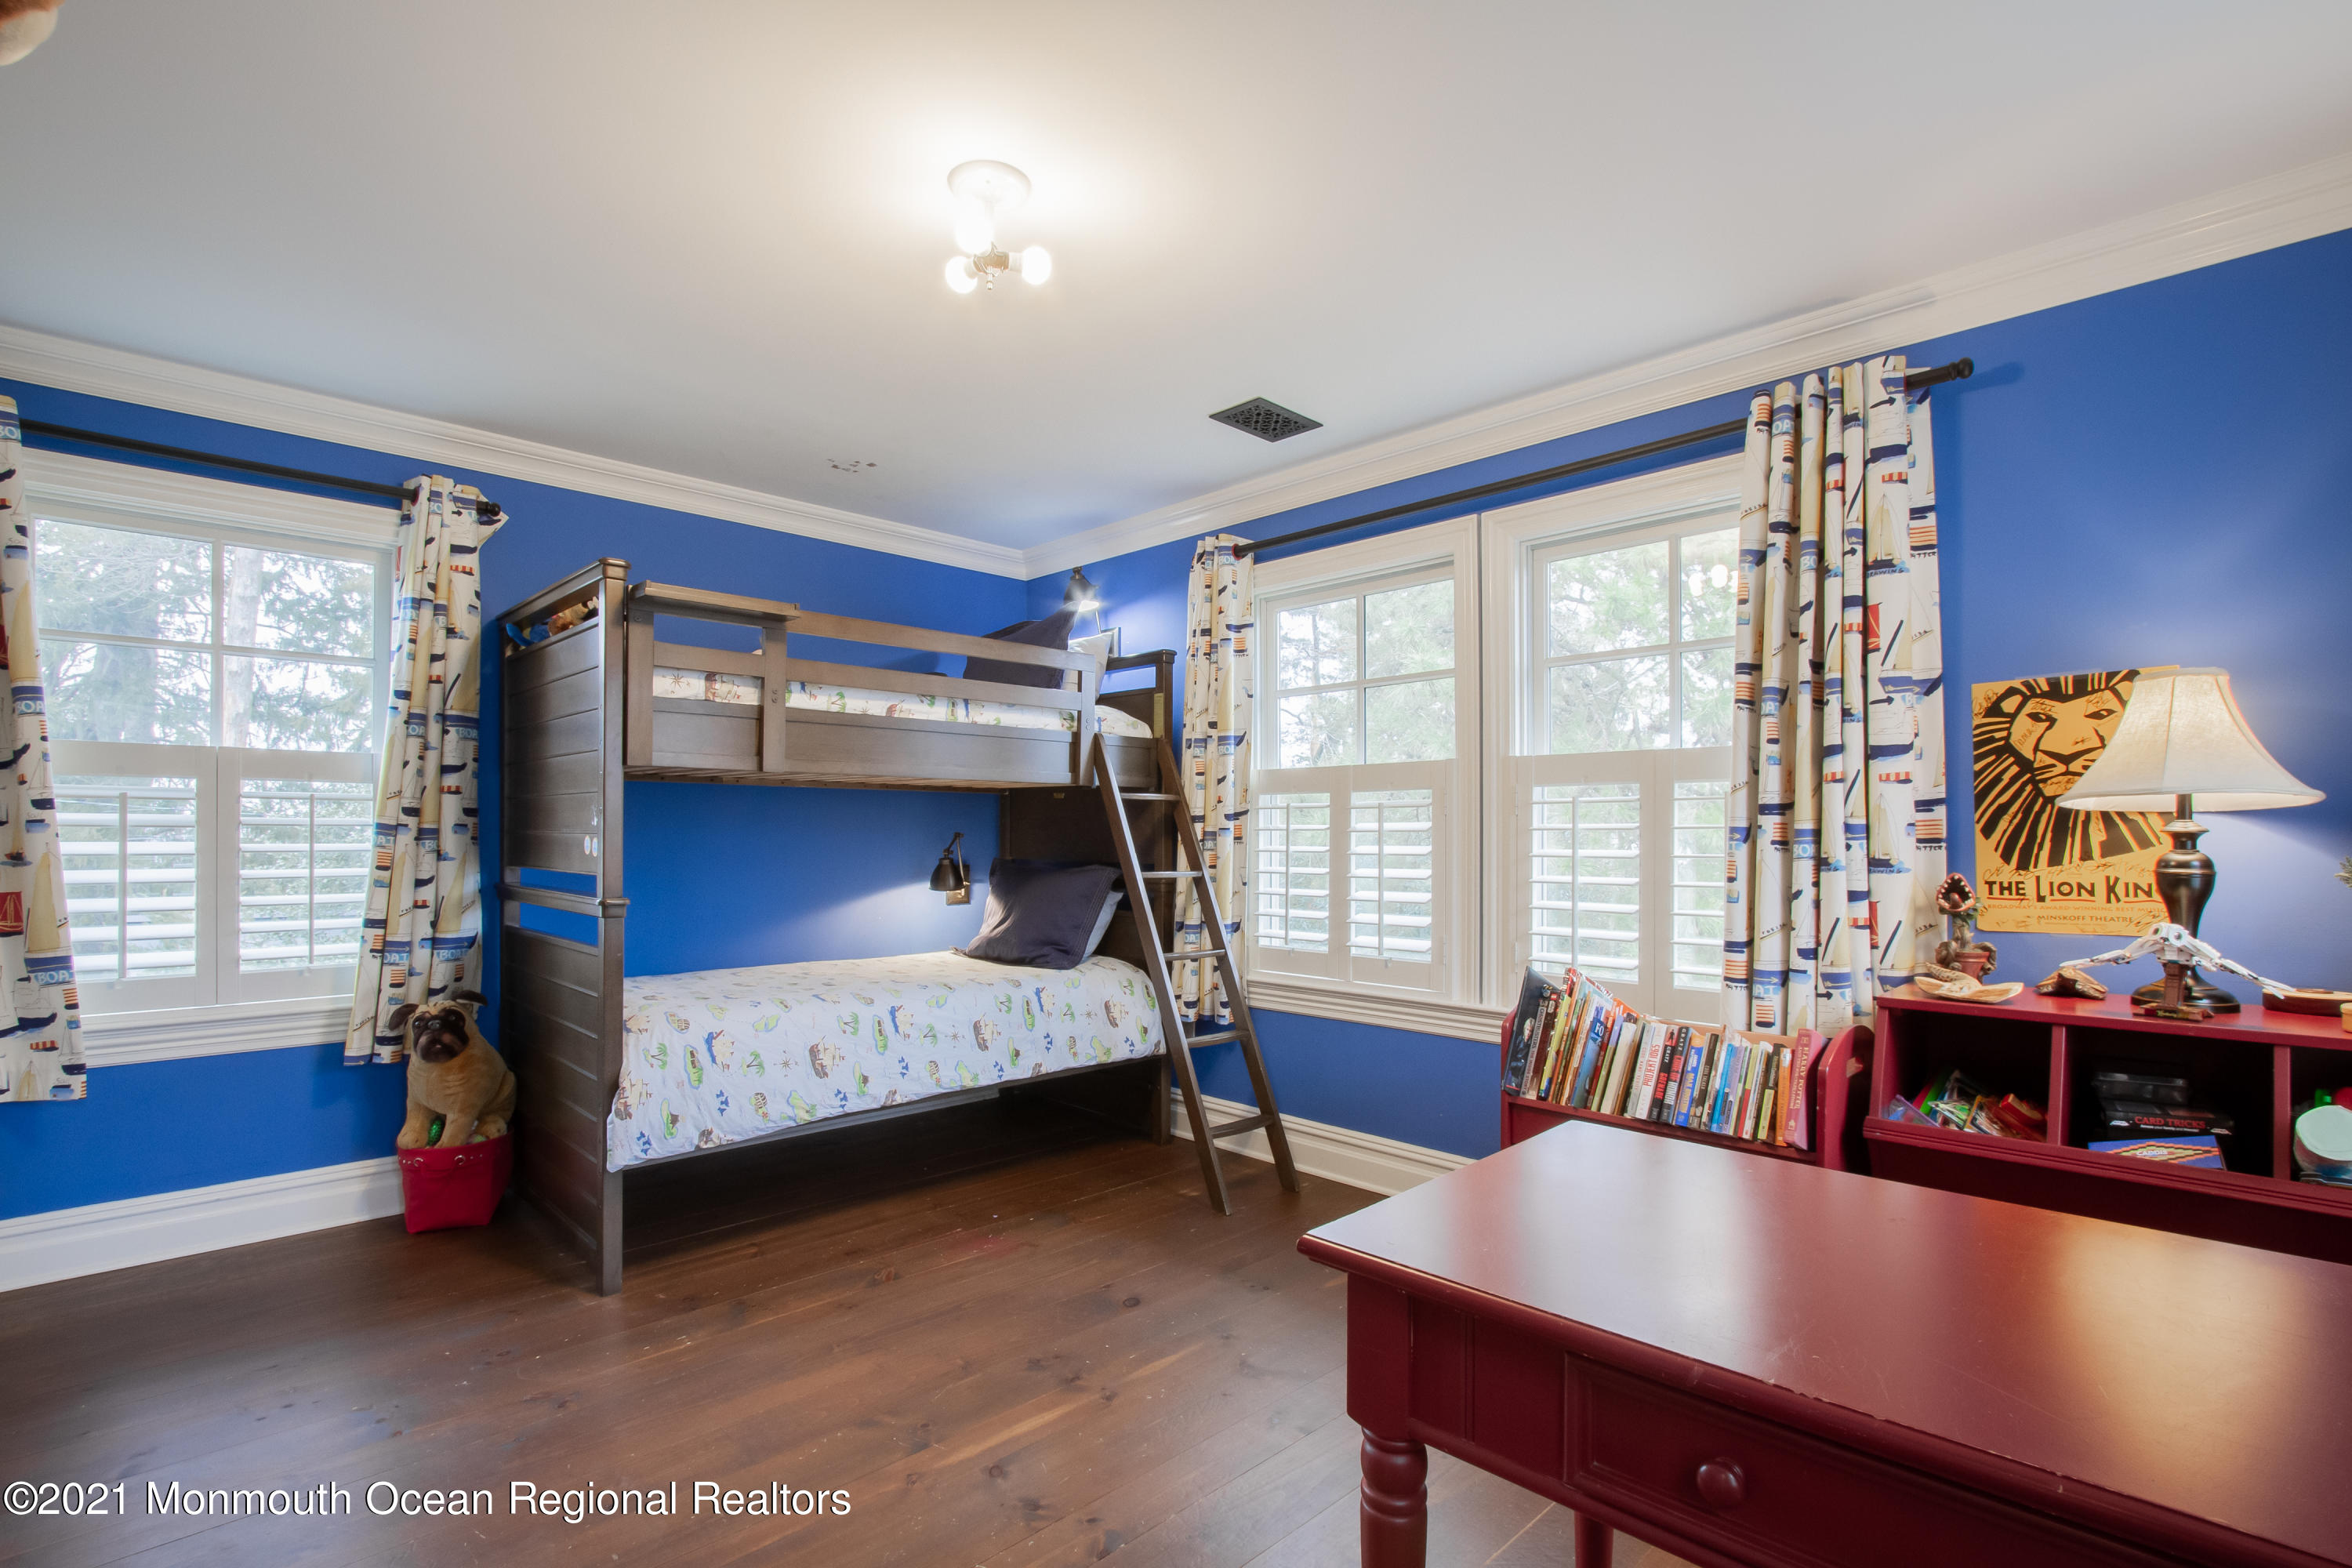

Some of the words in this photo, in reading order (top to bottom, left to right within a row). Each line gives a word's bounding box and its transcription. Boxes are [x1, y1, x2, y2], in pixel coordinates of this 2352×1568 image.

[1773, 419, 1794, 432] OA
[1870, 568, 1904, 577] RAWING
[16, 700, 45, 713] BOA
[459, 728, 479, 739] BOA
[1984, 880, 2027, 896] THE
[2035, 875, 2096, 902] LION
[2105, 875, 2154, 903] KIN
[39, 969, 74, 985] BOA
[1530, 1008, 1546, 1049] GHOSTBUSTERS
[1677, 1029, 1686, 1051] GRATZ
[1642, 1059, 1657, 1087] PROJEKT
[1799, 1047, 1809, 1077] HARRY
[1654, 1072, 1668, 1100] GRENADE
[1664, 1081, 1678, 1105] HONOR
[1795, 1079, 1805, 1109] POTTER
[2135, 1116, 2164, 1125] CARD
[2166, 1119, 2205, 1129] TRICKS
